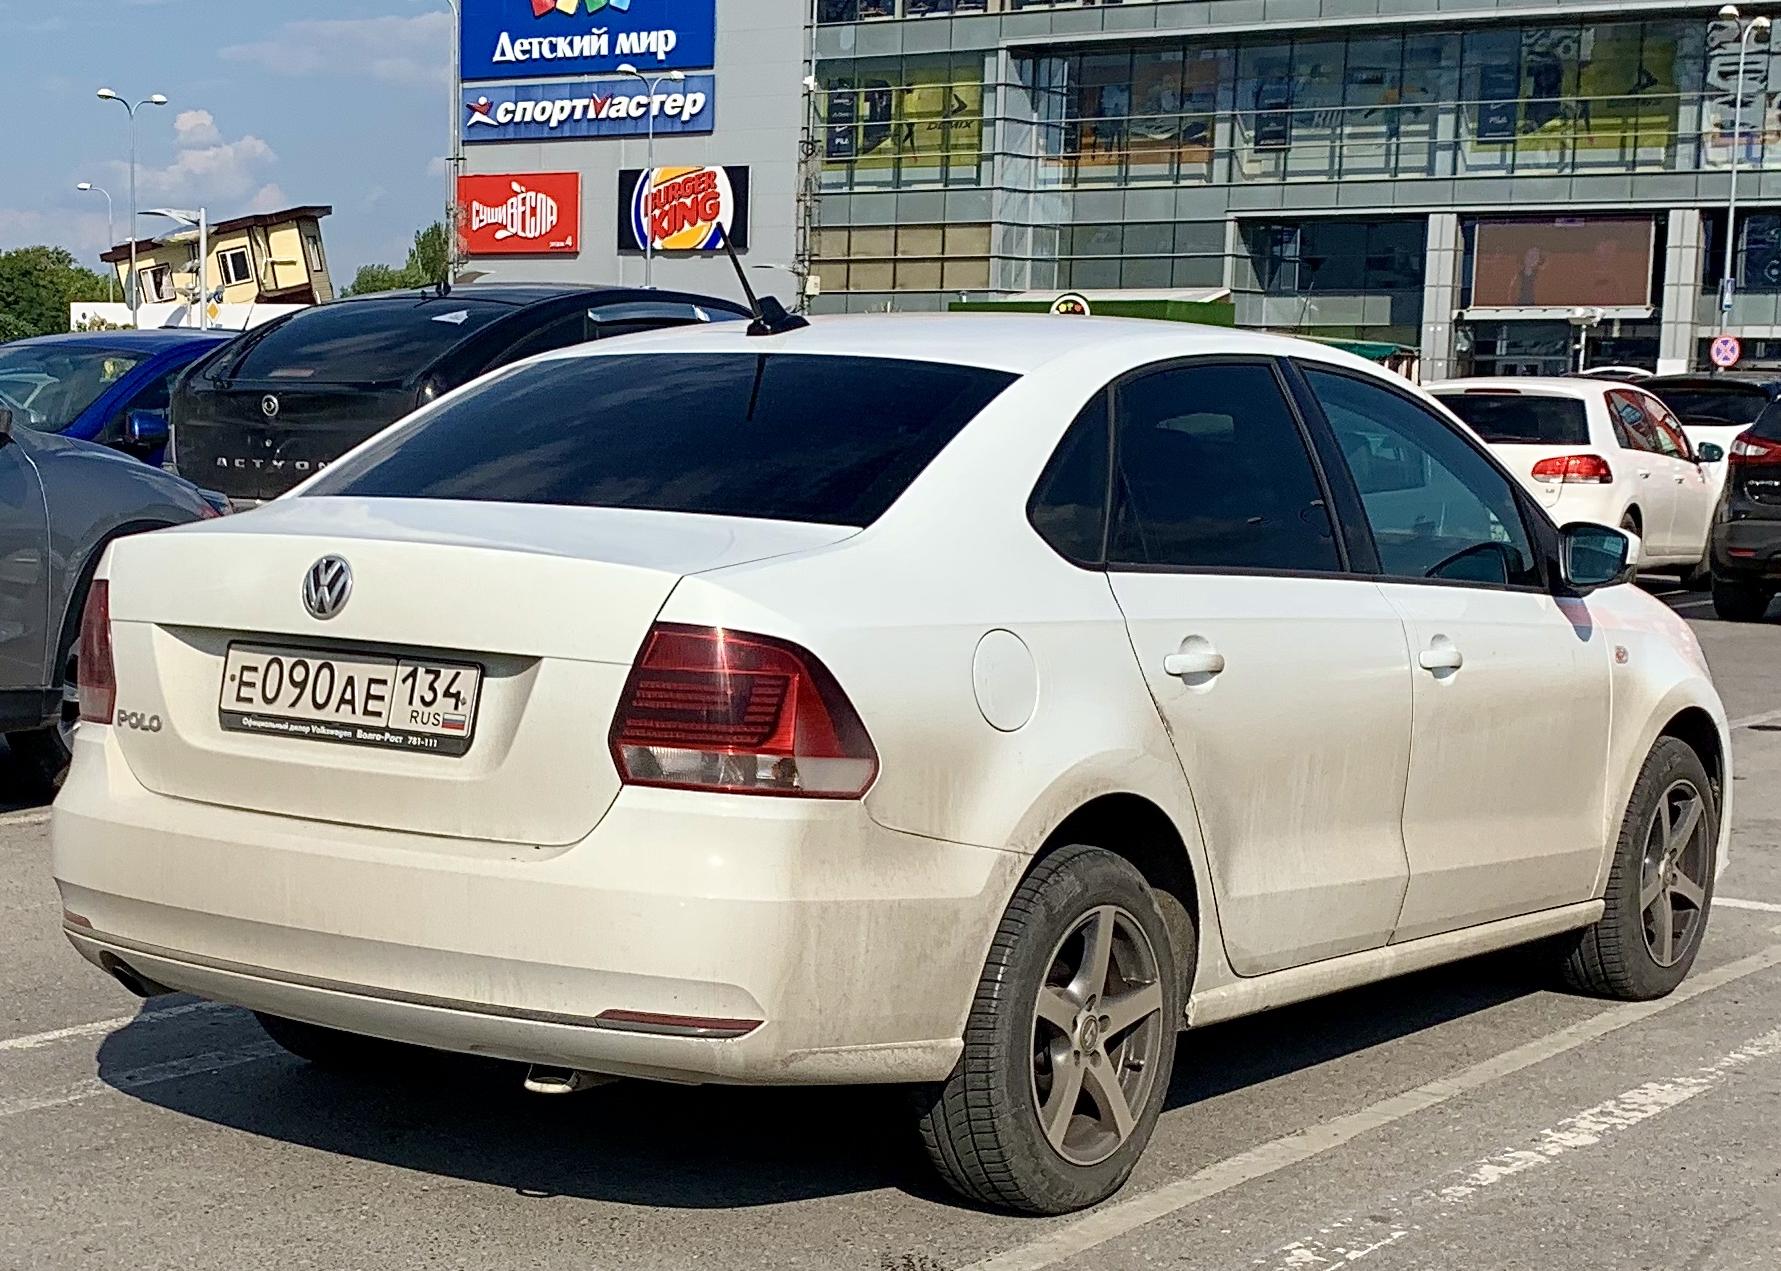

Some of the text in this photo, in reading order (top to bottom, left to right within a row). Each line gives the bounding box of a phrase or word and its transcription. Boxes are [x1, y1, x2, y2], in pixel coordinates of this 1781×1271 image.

[492, 27, 677, 62] Детский мир
[650, 190, 720, 244] KING
[401, 667, 462, 711] 134
[117, 709, 163, 733] POLO
[409, 709, 441, 727] RUS
